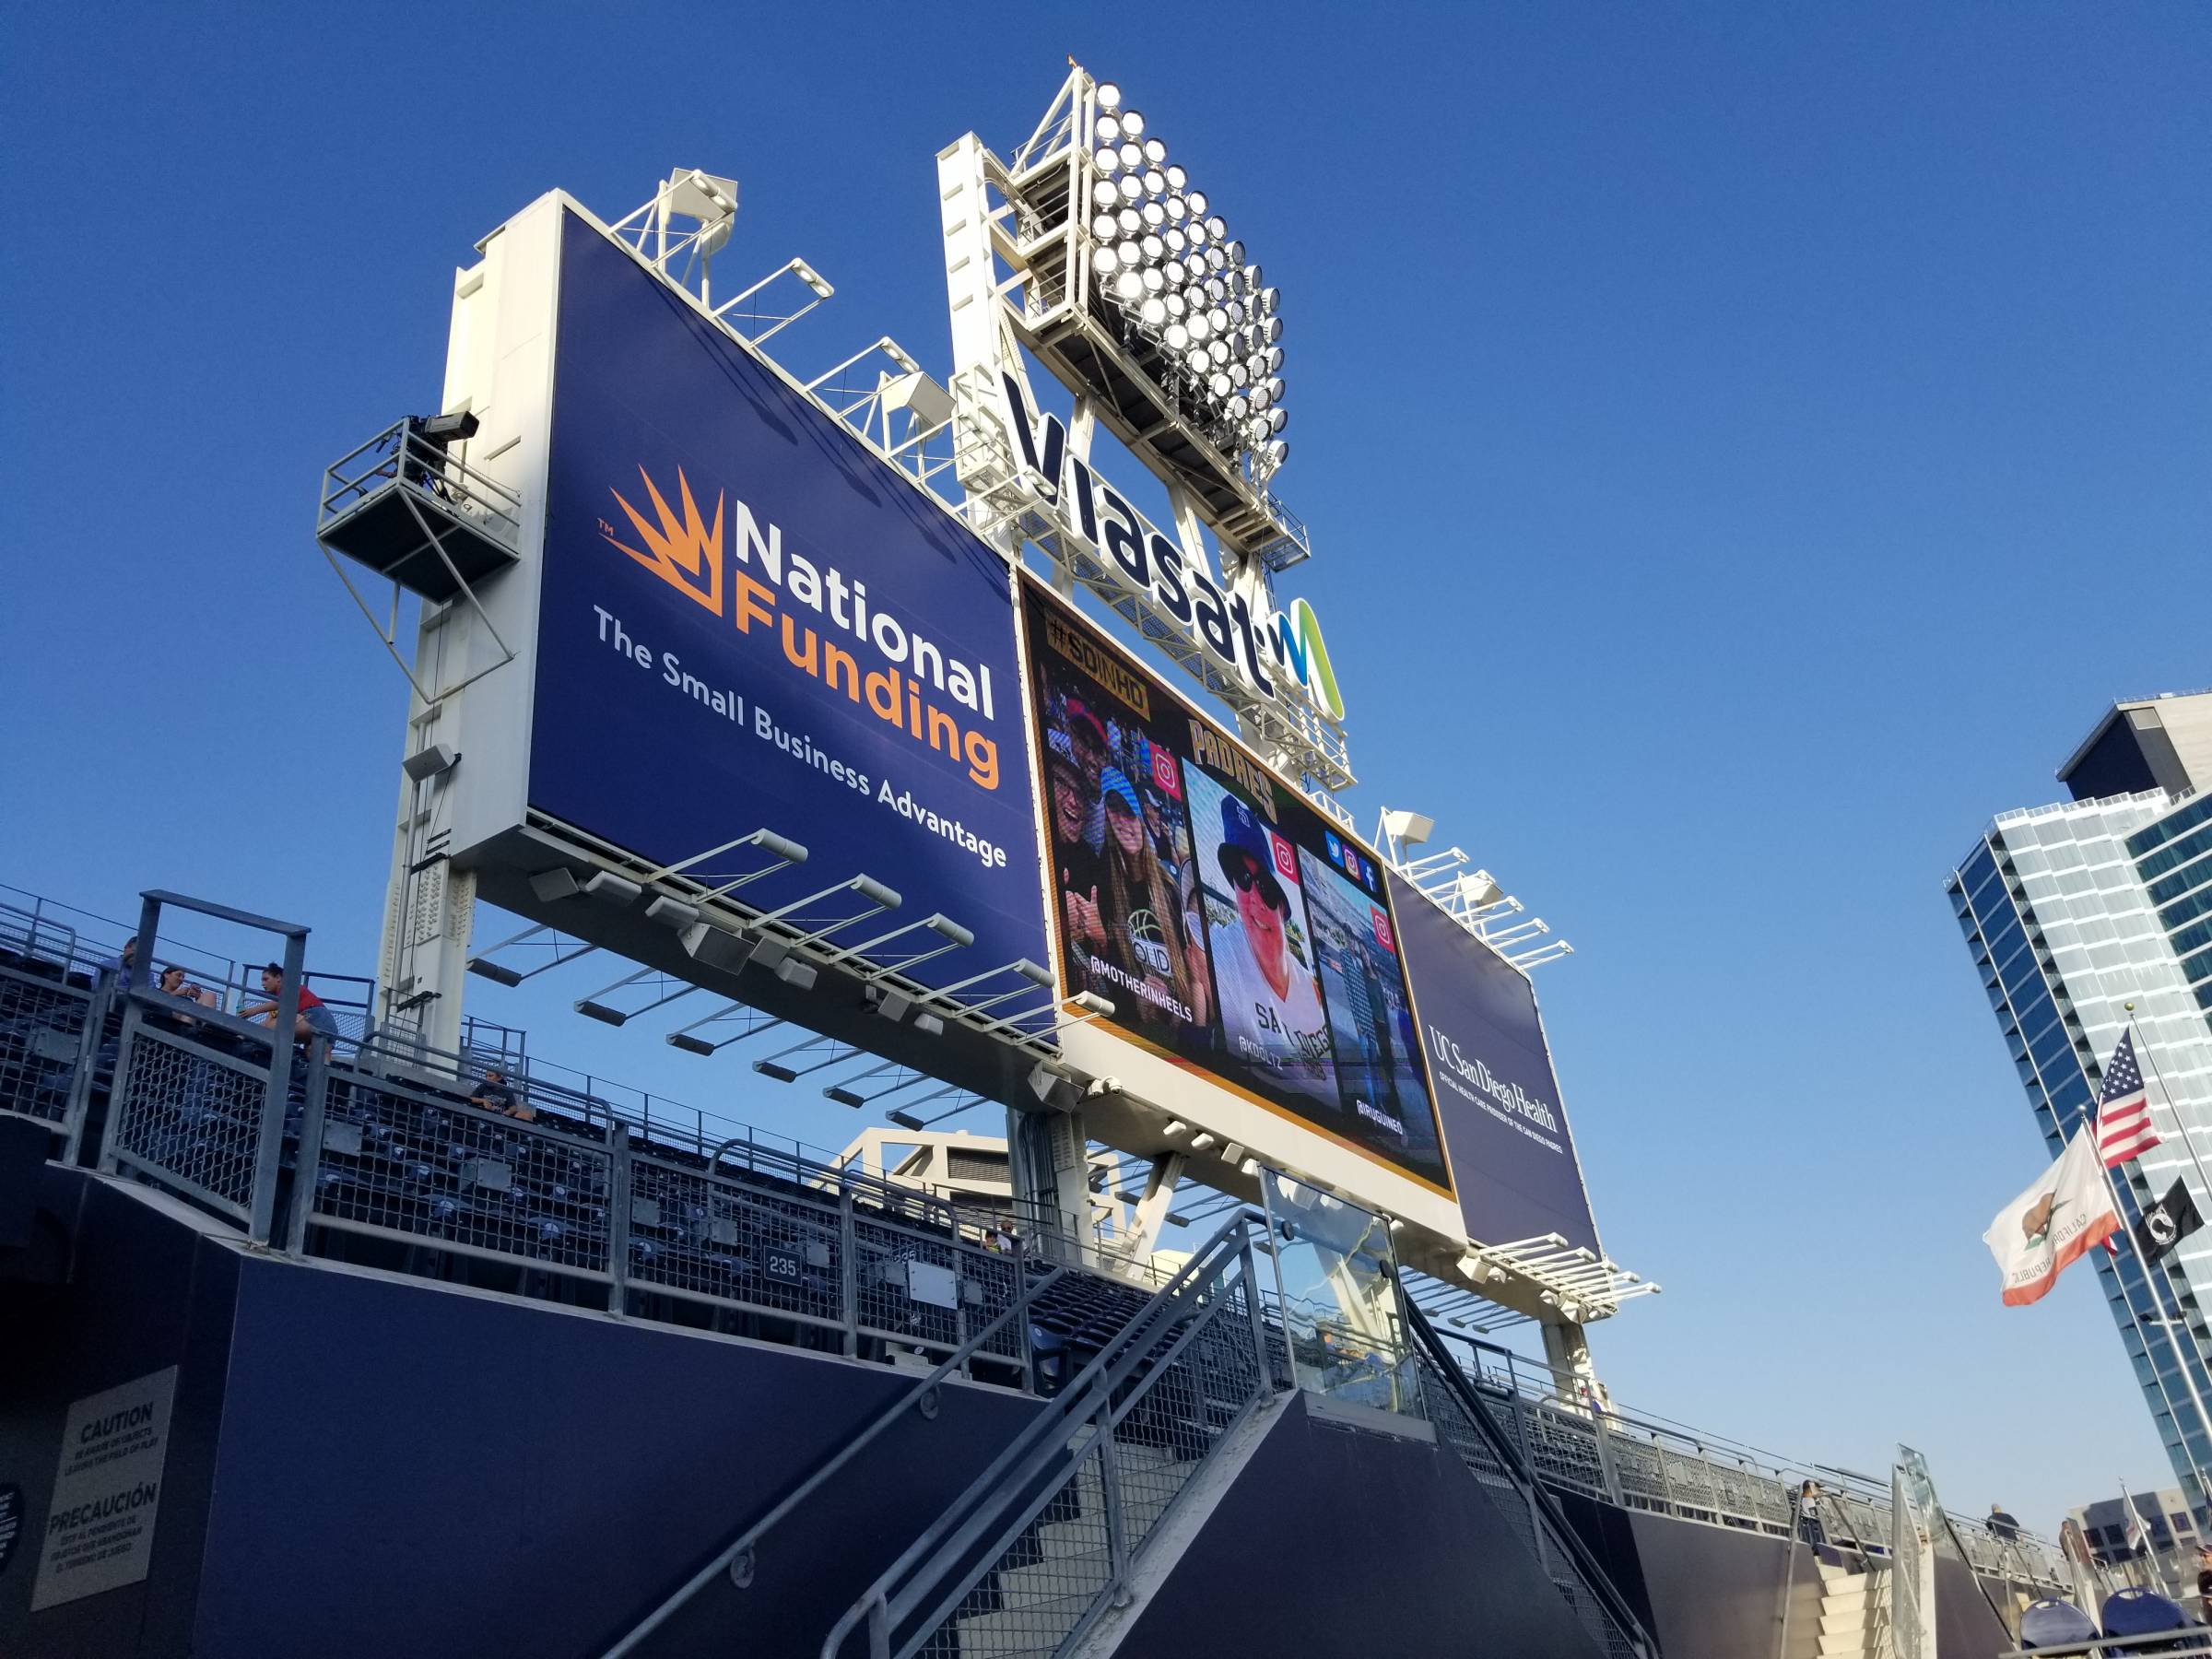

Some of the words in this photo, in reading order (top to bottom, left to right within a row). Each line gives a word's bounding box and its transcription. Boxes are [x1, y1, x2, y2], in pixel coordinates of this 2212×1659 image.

[999, 370, 1276, 702] Viasat
[736, 499, 994, 721] National
[735, 569, 1000, 790] Funding
[1049, 618, 1145, 710] #SDINHD
[594, 605, 653, 670] The
[663, 652, 745, 726] Small
[755, 705, 870, 796] Business
[877, 779, 1007, 868] Advantage
[1188, 719, 1277, 825] PADRES
[1090, 955, 1193, 1023] @MOTHERINHEELS
[1429, 1024, 1455, 1070] UC
[1452, 1042, 1480, 1088] San
[1475, 1058, 1516, 1113] Diego
[1511, 1082, 1559, 1134] Health
[1439, 1070, 1459, 1091] OFFICIAL
[1457, 1085, 1476, 1103] HEALTH
[1474, 1096, 1487, 1111] CARE
[1486, 1103, 1509, 1124] PROVIDER
[1513, 1120, 1524, 1133] THE
[1523, 1126, 1533, 1138] SAN
[1531, 1131, 1546, 1146] DIEGO
[770, 1255, 796, 1277] 235
[81, 1402, 154, 1444] CAUTION
[49, 1482, 157, 1535] PRECAUCIÓN
